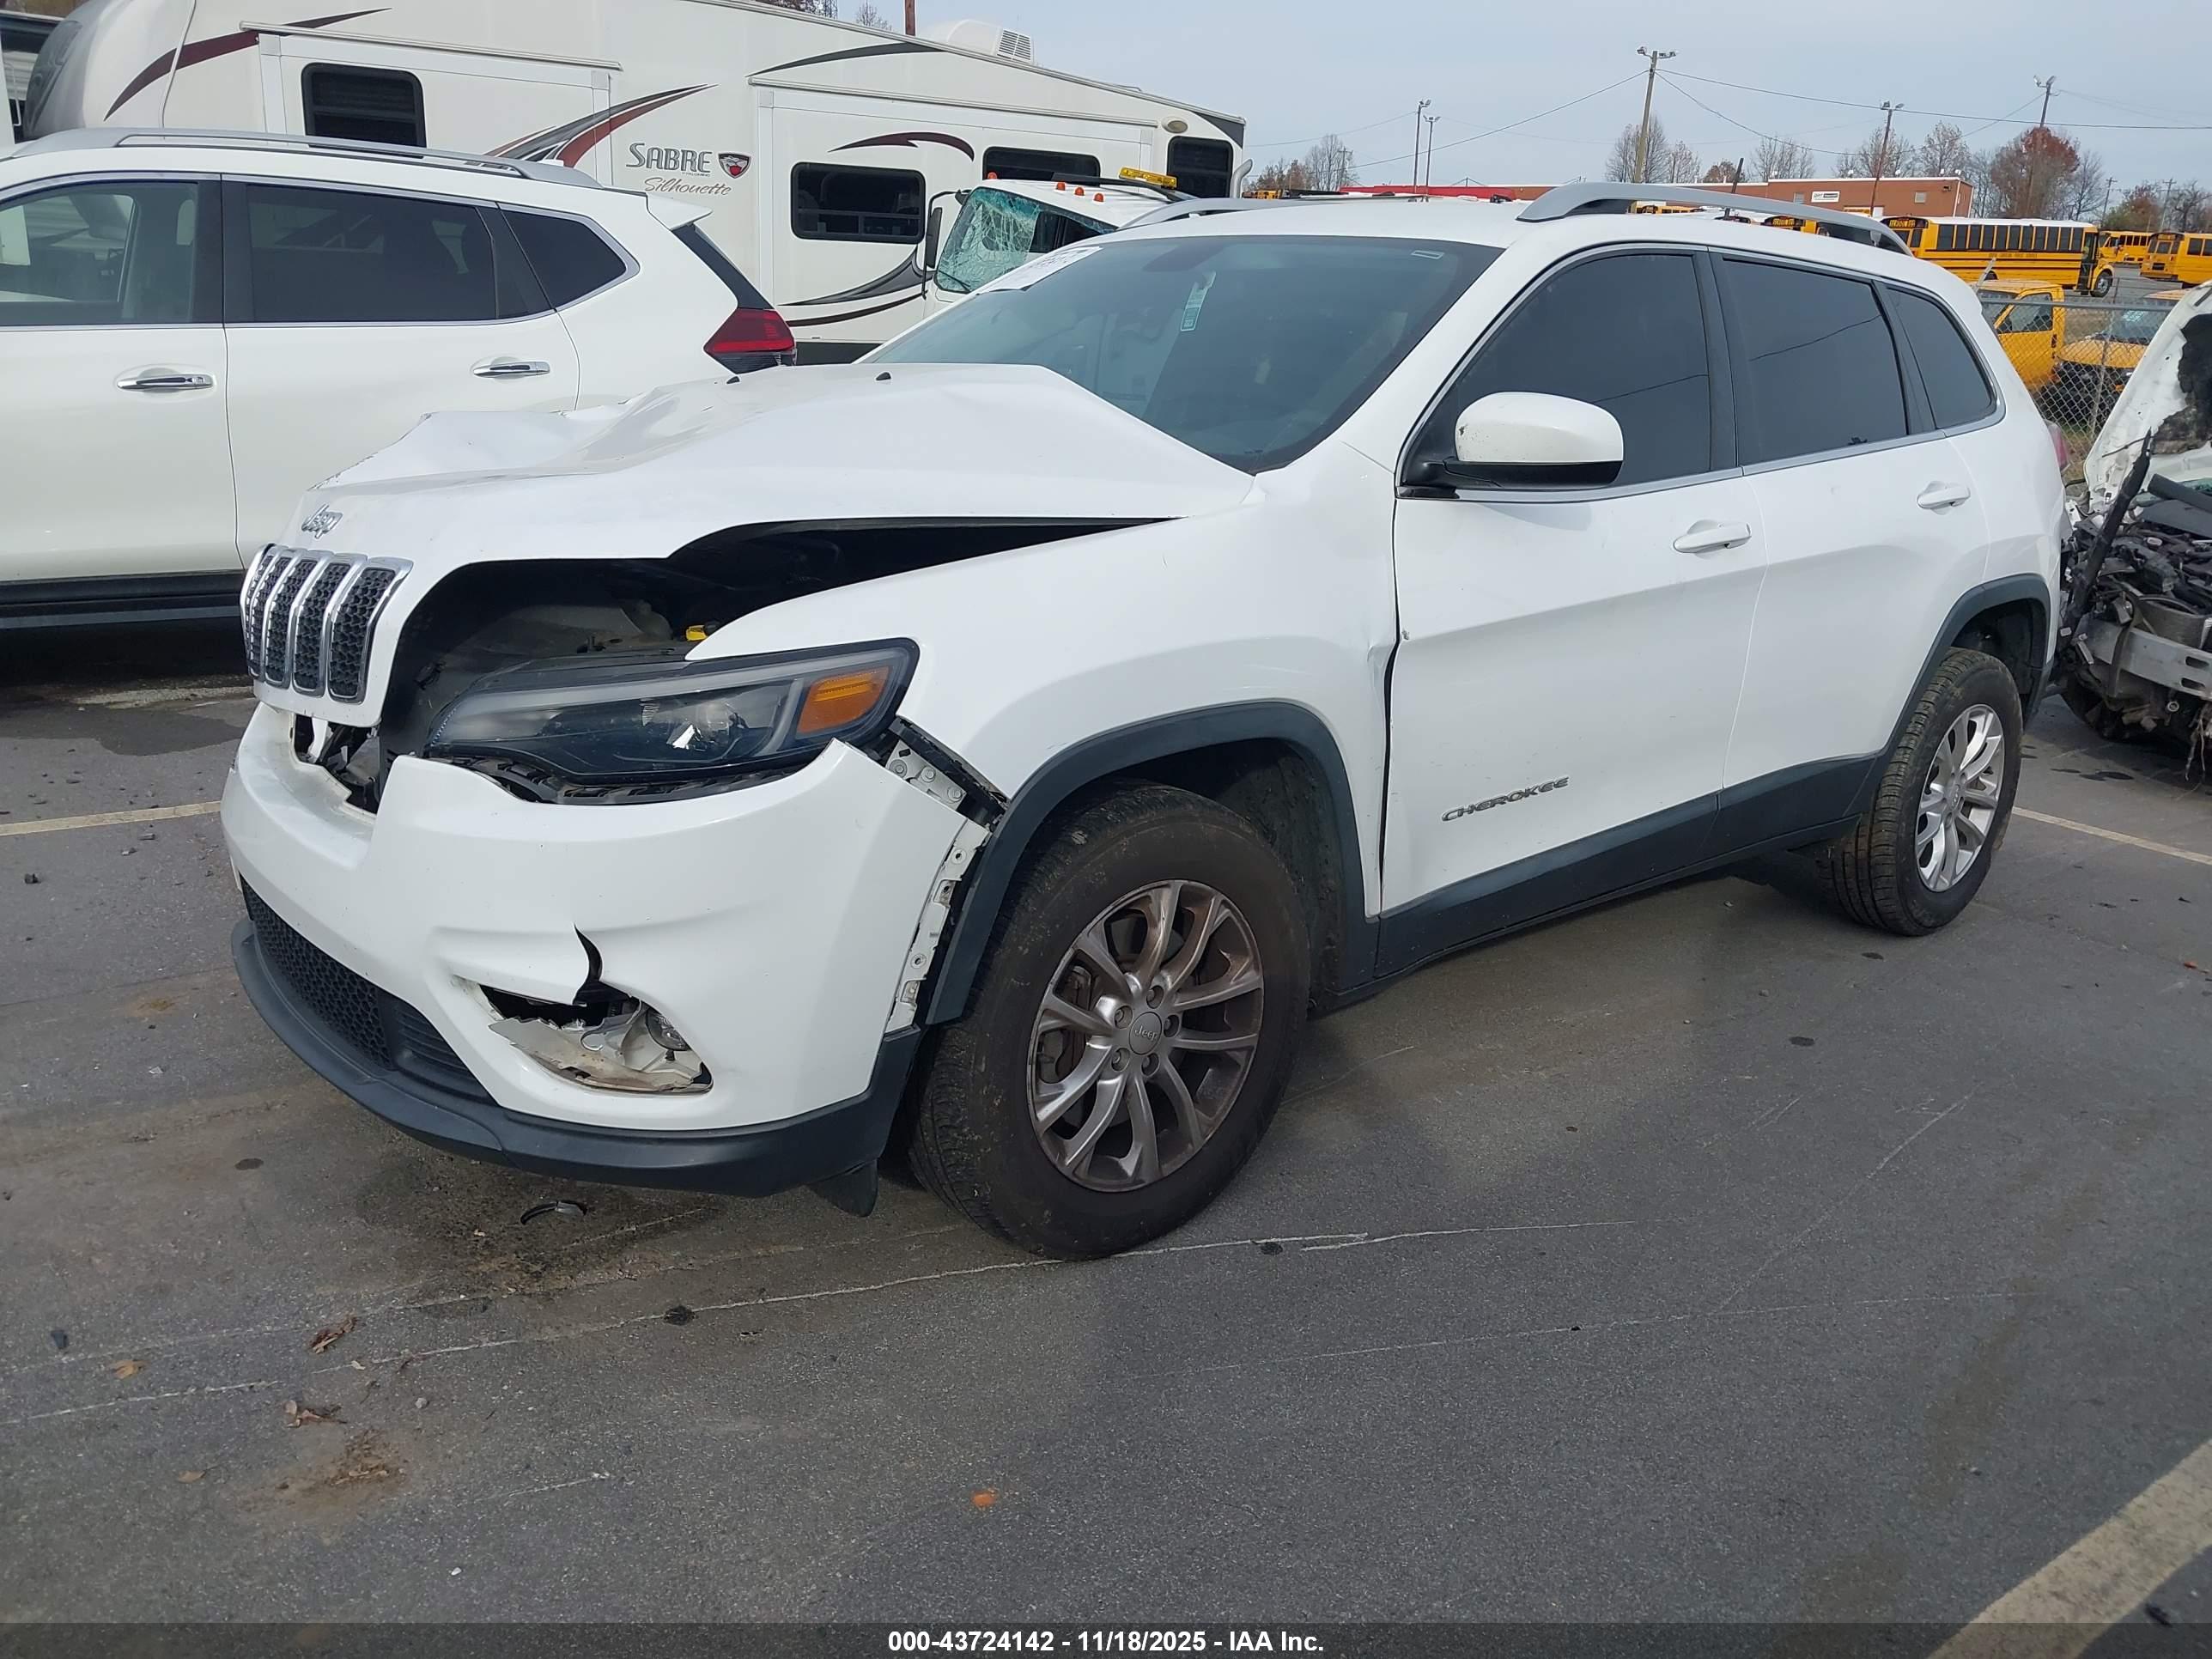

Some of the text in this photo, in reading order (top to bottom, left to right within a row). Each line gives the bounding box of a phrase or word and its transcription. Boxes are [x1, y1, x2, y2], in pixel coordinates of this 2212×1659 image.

[626, 142, 713, 173] SABRE
[644, 177, 732, 196] Silhouette
[1441, 776, 1570, 822] CHEROKEE
[1134, 1024, 1158, 1042] Jeep
